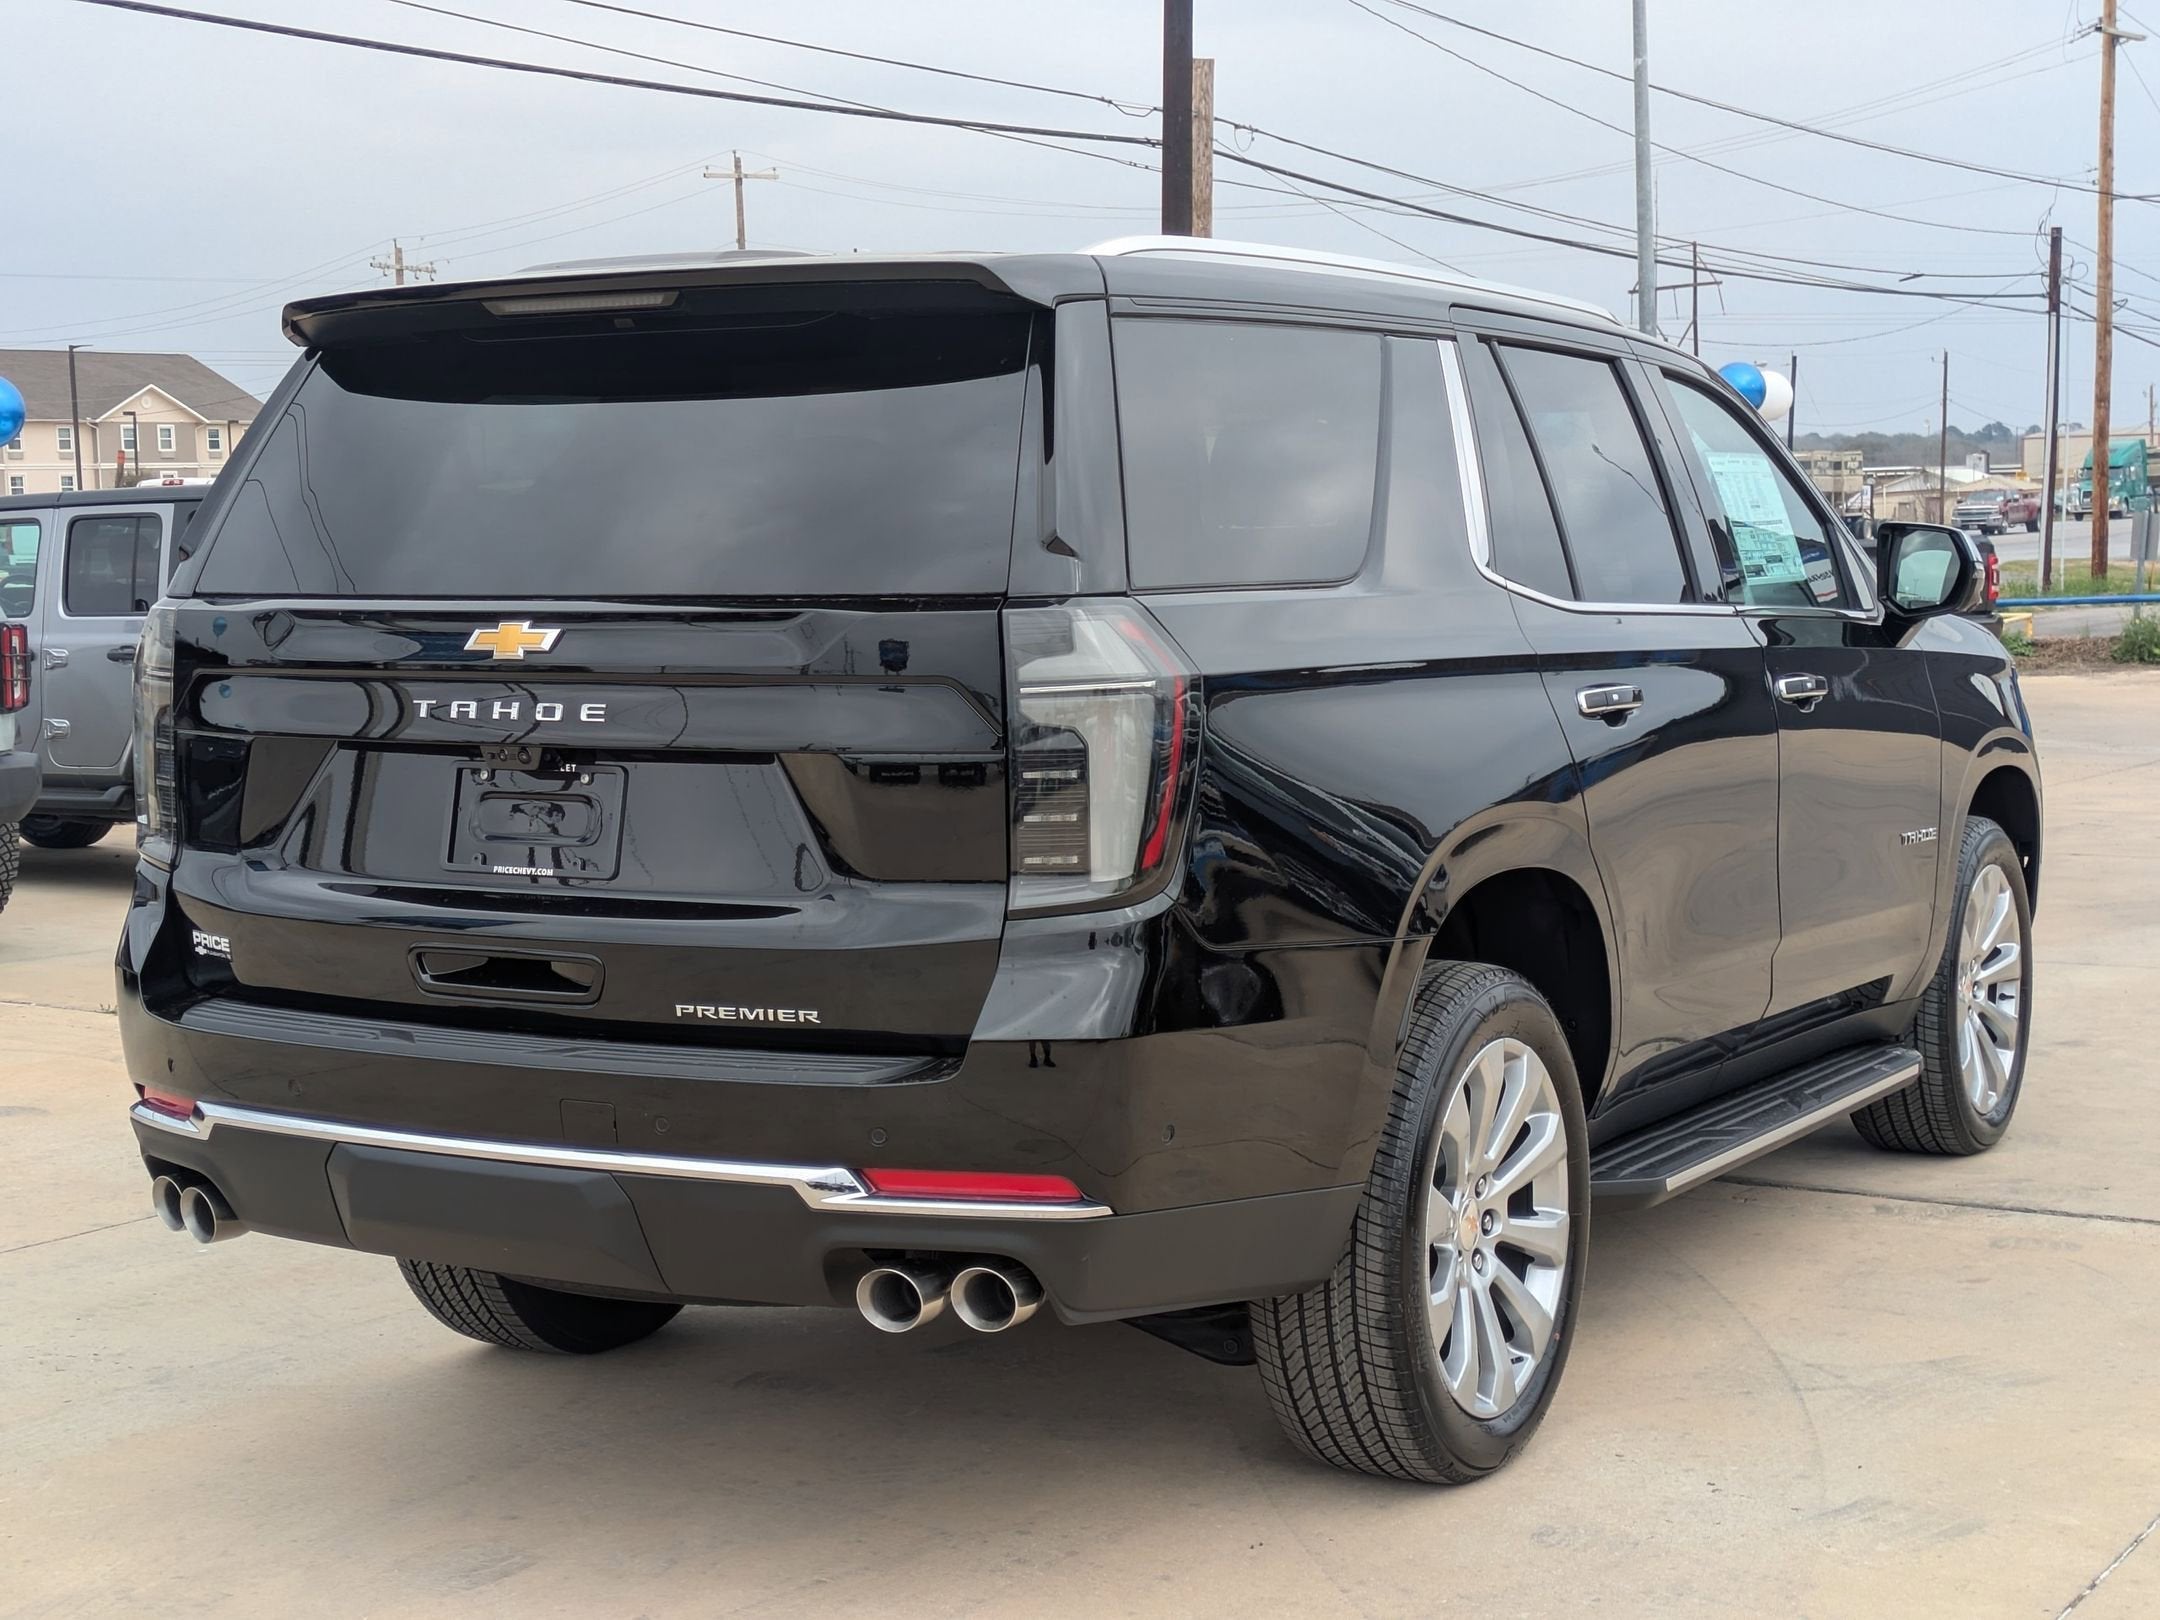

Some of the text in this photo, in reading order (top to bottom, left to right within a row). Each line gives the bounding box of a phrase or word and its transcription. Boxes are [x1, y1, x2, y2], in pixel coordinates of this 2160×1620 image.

[413, 700, 607, 722] TAHOE
[1900, 827, 1937, 846] TAHOE
[493, 866, 554, 876] PRICECHEVY.COM
[192, 930, 231, 952] PRICE
[675, 1003, 822, 1024] PREMIER
